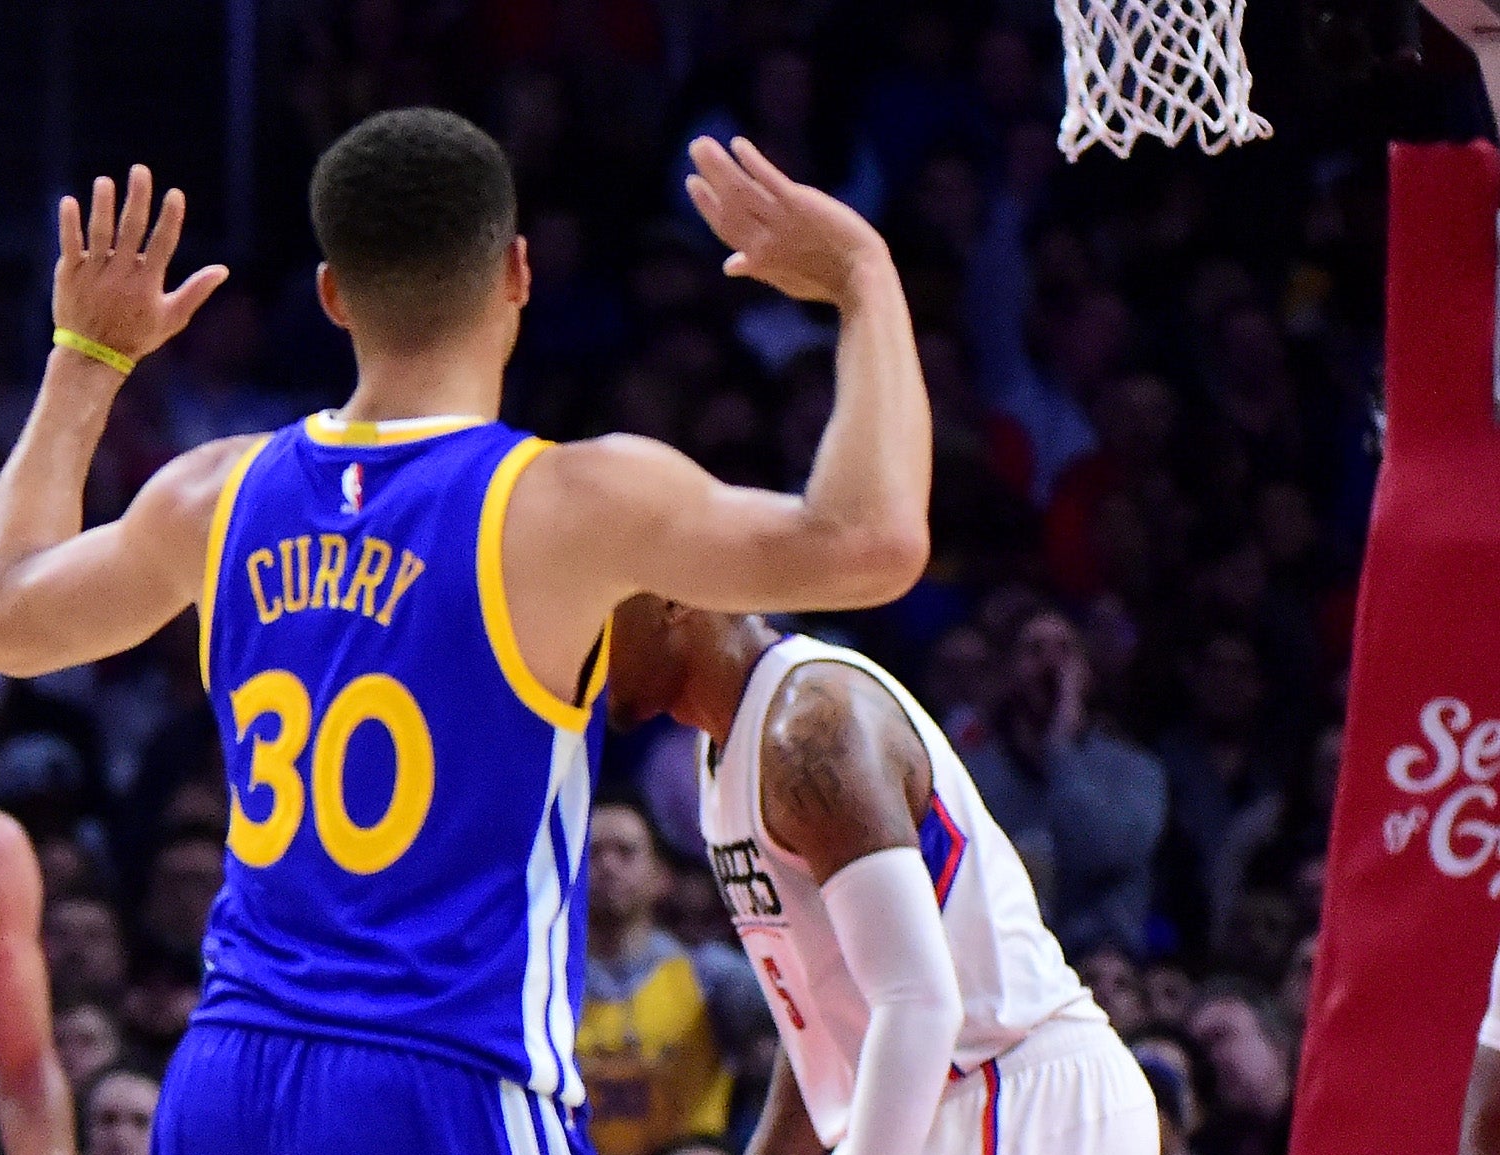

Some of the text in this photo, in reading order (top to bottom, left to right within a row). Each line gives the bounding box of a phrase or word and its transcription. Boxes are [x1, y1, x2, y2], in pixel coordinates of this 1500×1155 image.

[246, 533, 426, 627] CURRY
[225, 668, 436, 876] 30
[1428, 782, 1500, 878] G
